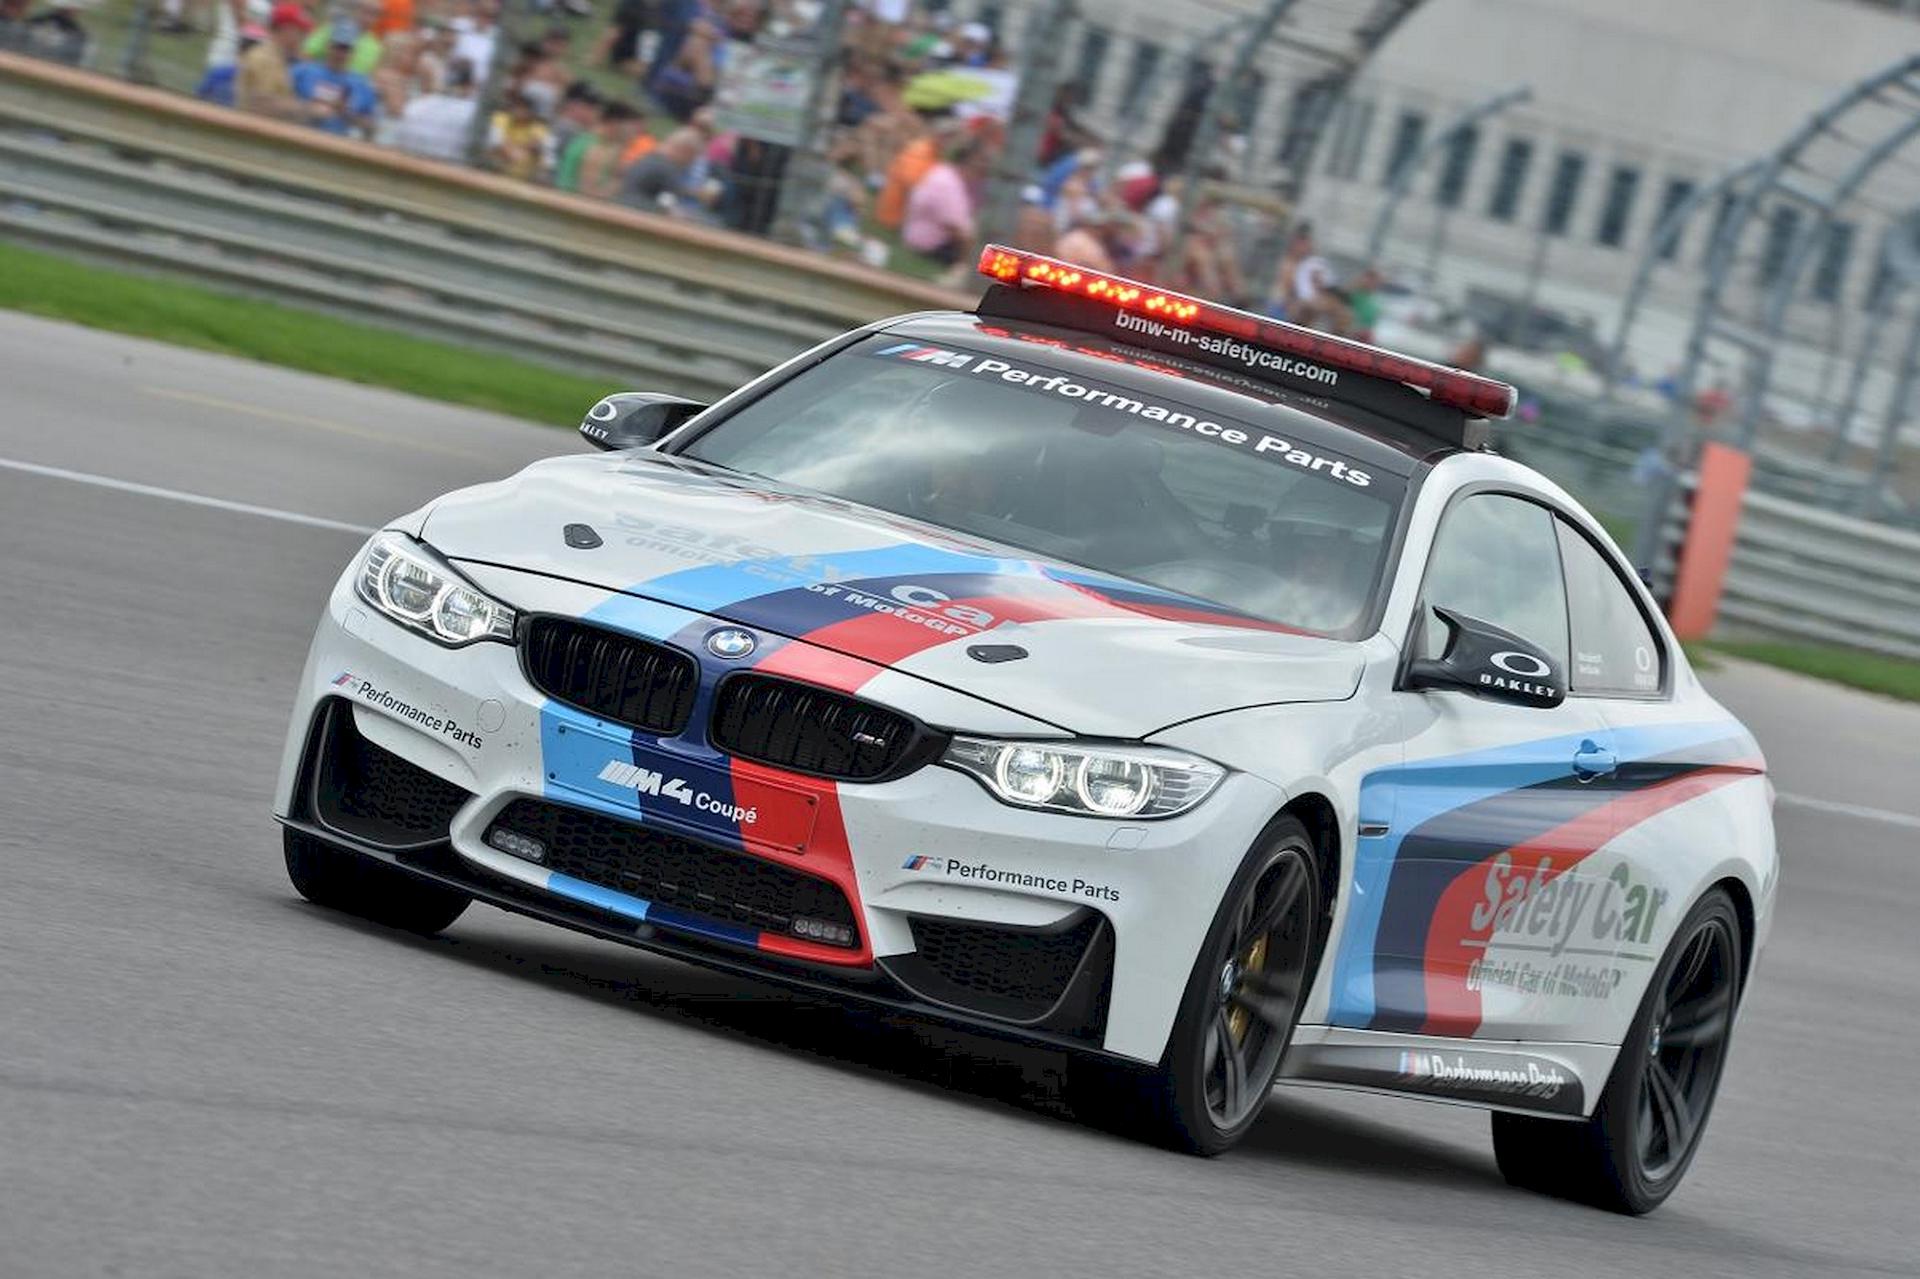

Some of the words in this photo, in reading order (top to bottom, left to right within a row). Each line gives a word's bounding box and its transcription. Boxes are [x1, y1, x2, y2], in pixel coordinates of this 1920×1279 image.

[1115, 309, 1339, 386] bmw-m-safetycar.com
[971, 359, 1249, 445] Performance
[1255, 435, 1372, 488] Parts
[844, 591, 969, 637] MotoGP
[1480, 673, 1556, 698] OAKLEY
[357, 681, 443, 731] Performance
[442, 719, 484, 749] Parts
[695, 792, 758, 824] Coupé
[946, 858, 1067, 892] Performance
[1072, 879, 1120, 902] Parts
[1471, 852, 1594, 957] Safety
[1591, 861, 1669, 944] Car
